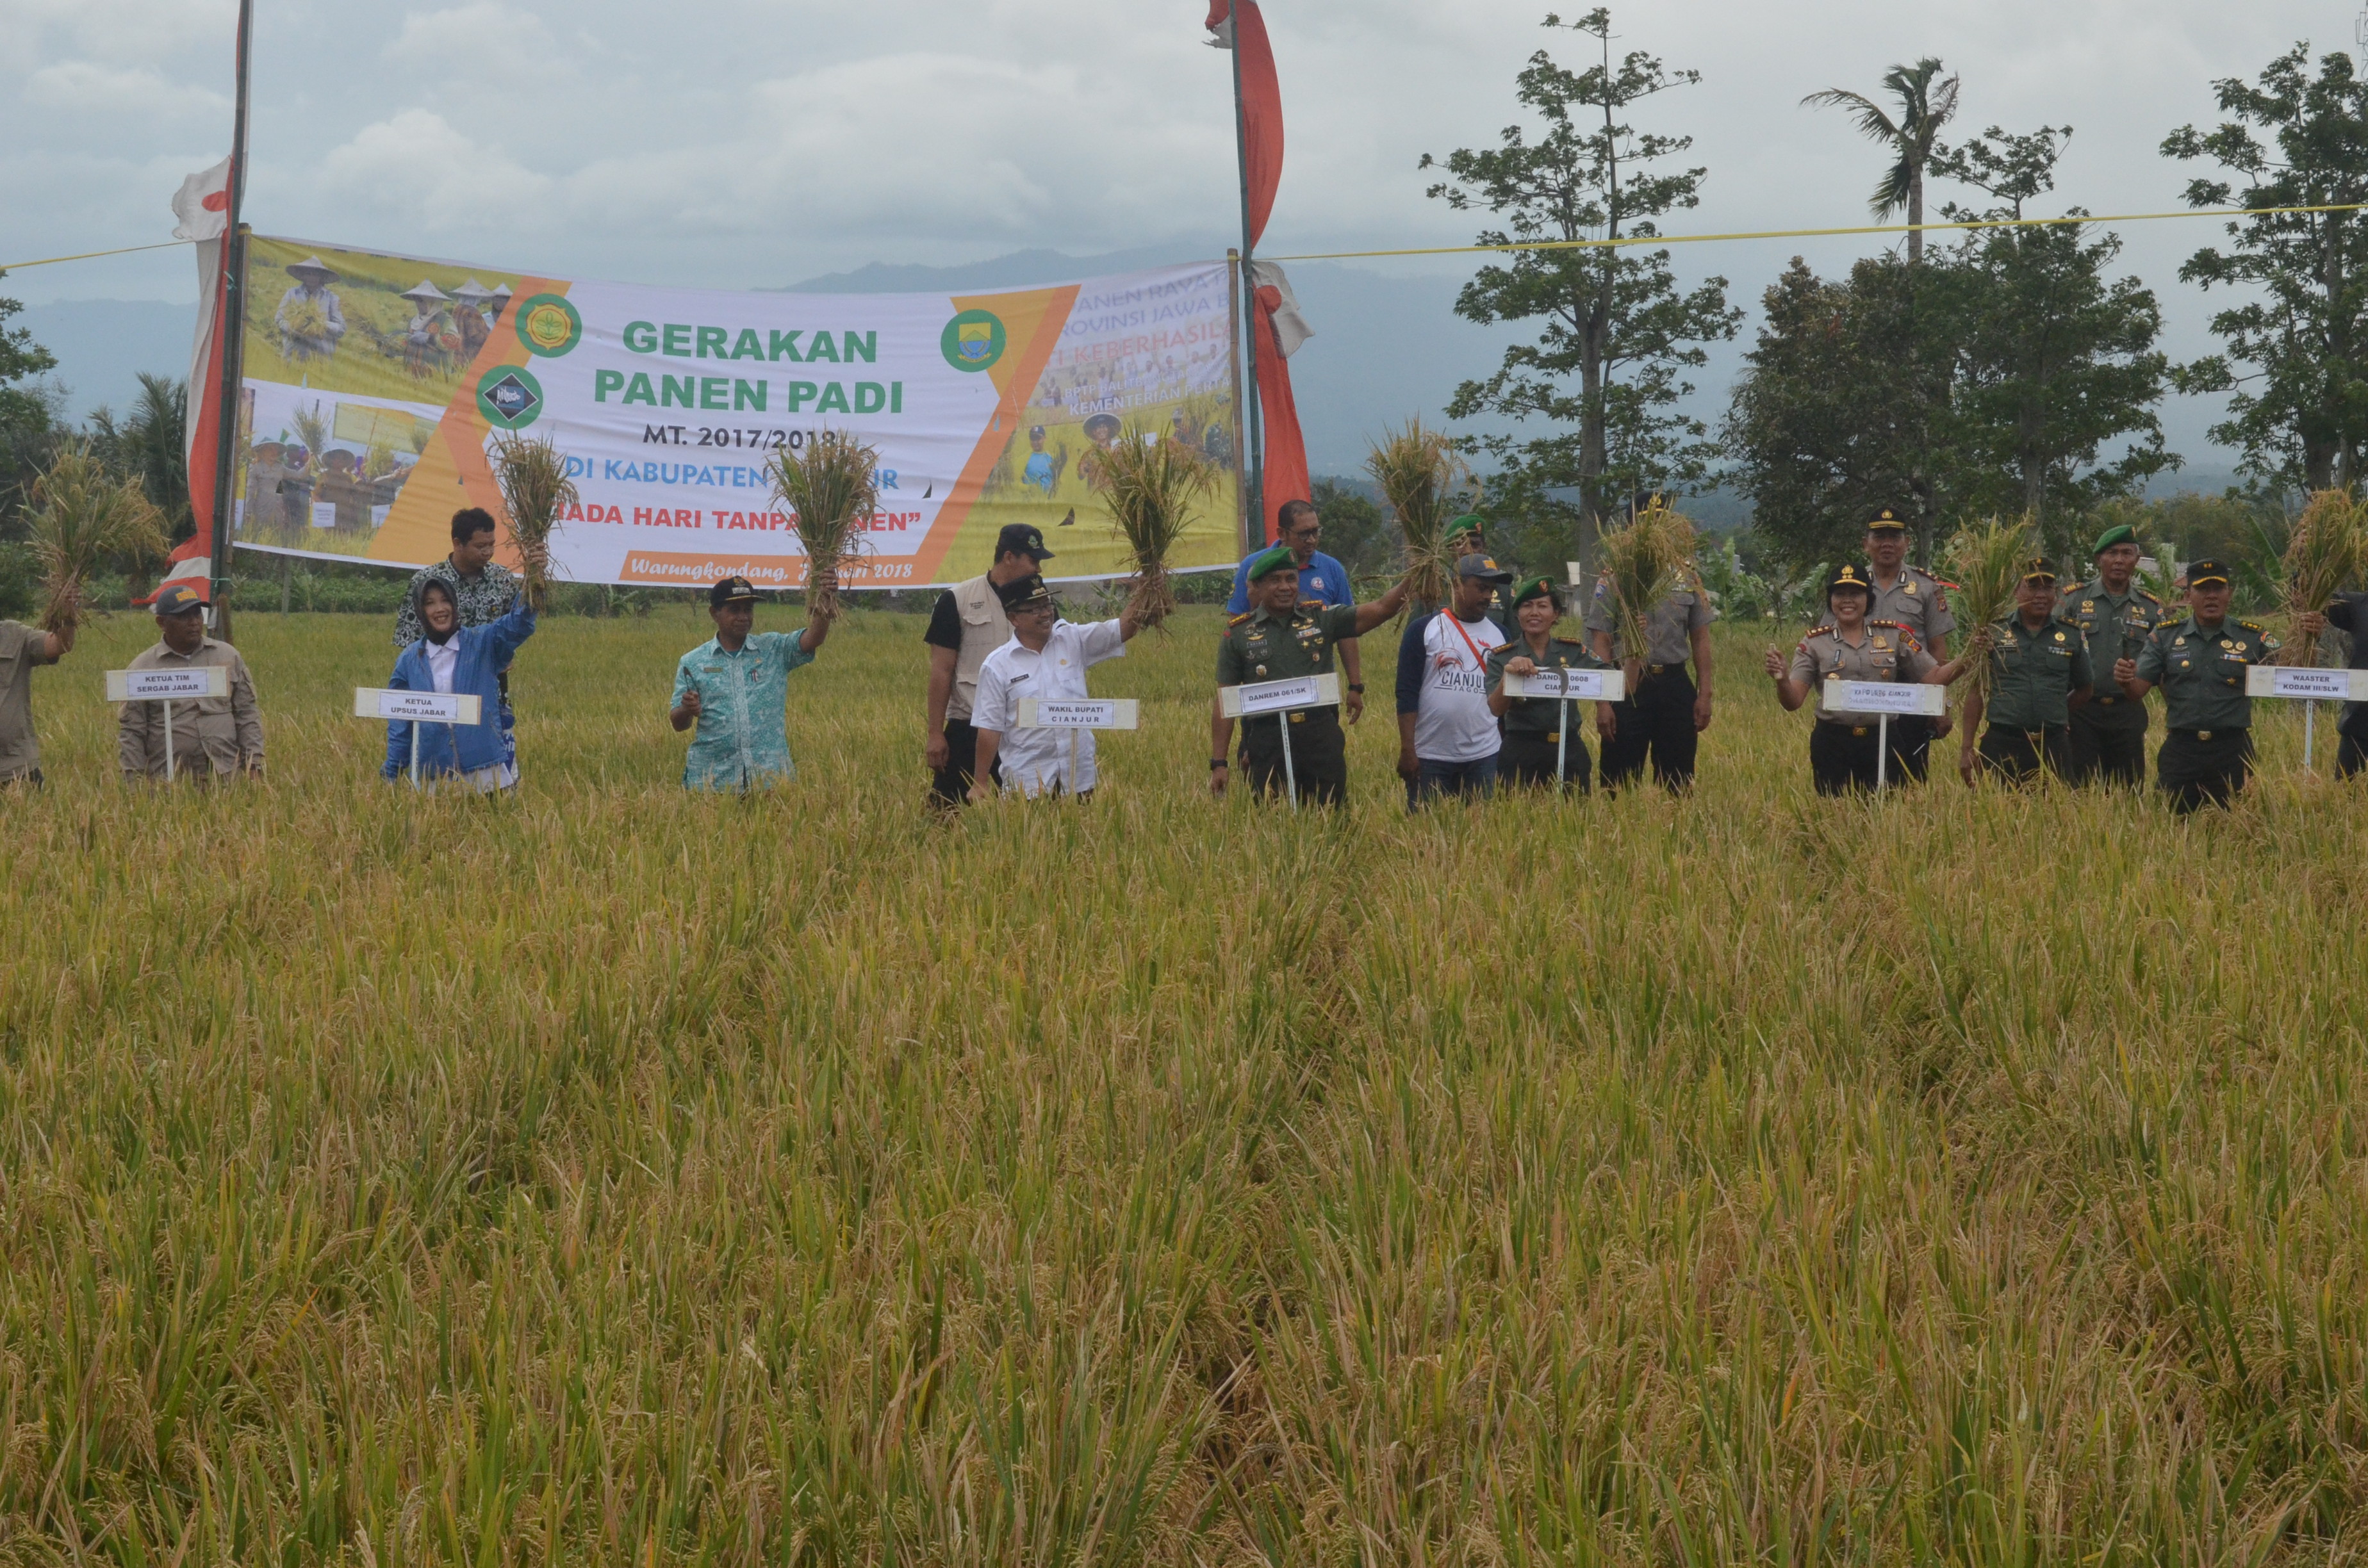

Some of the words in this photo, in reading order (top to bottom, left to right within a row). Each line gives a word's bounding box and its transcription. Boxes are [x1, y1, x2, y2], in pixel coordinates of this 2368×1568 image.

[1153, 297, 1210, 322] JAWA
[623, 320, 876, 363] GERAKAN
[595, 369, 768, 411] PANEN
[788, 381, 902, 414] PADI
[1064, 384, 1096, 398] BPTP
[1069, 386, 1181, 416] KEMENTERIAN
[643, 423, 687, 446] MT.
[698, 427, 836, 450] 2017/2018
[566, 455, 593, 479] DI
[605, 459, 768, 488] KABUPATEN
[634, 507, 701, 528] HARI
[631, 557, 788, 582] Warungkondang,
[873, 563, 913, 578] 2018
[1454, 685, 1479, 694] JAGO
[2293, 674, 2330, 683] WAASTER
[1249, 691, 1280, 701] DANREM
[1281, 687, 1306, 696] 061/SK
